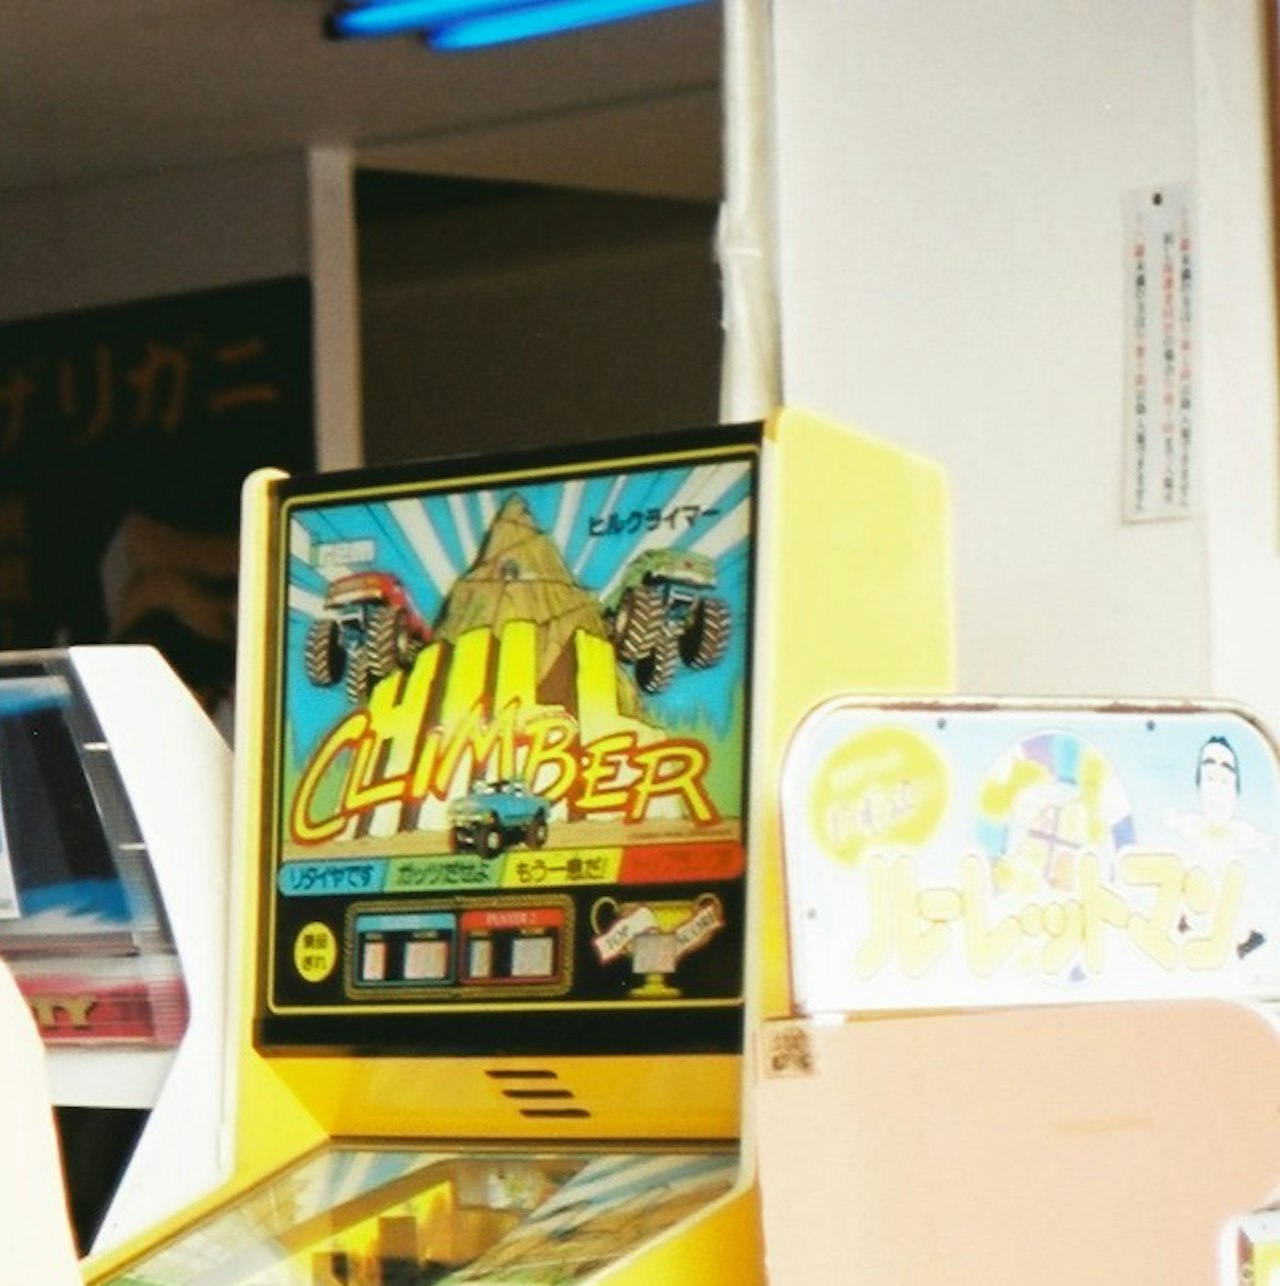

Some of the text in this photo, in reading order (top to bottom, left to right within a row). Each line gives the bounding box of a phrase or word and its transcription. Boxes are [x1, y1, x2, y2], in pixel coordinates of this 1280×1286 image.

[589, 504, 720, 537] ヒルクライマー
[288, 694, 721, 847] CLIMBER
[853, 850, 1244, 984] ルーレットマン
